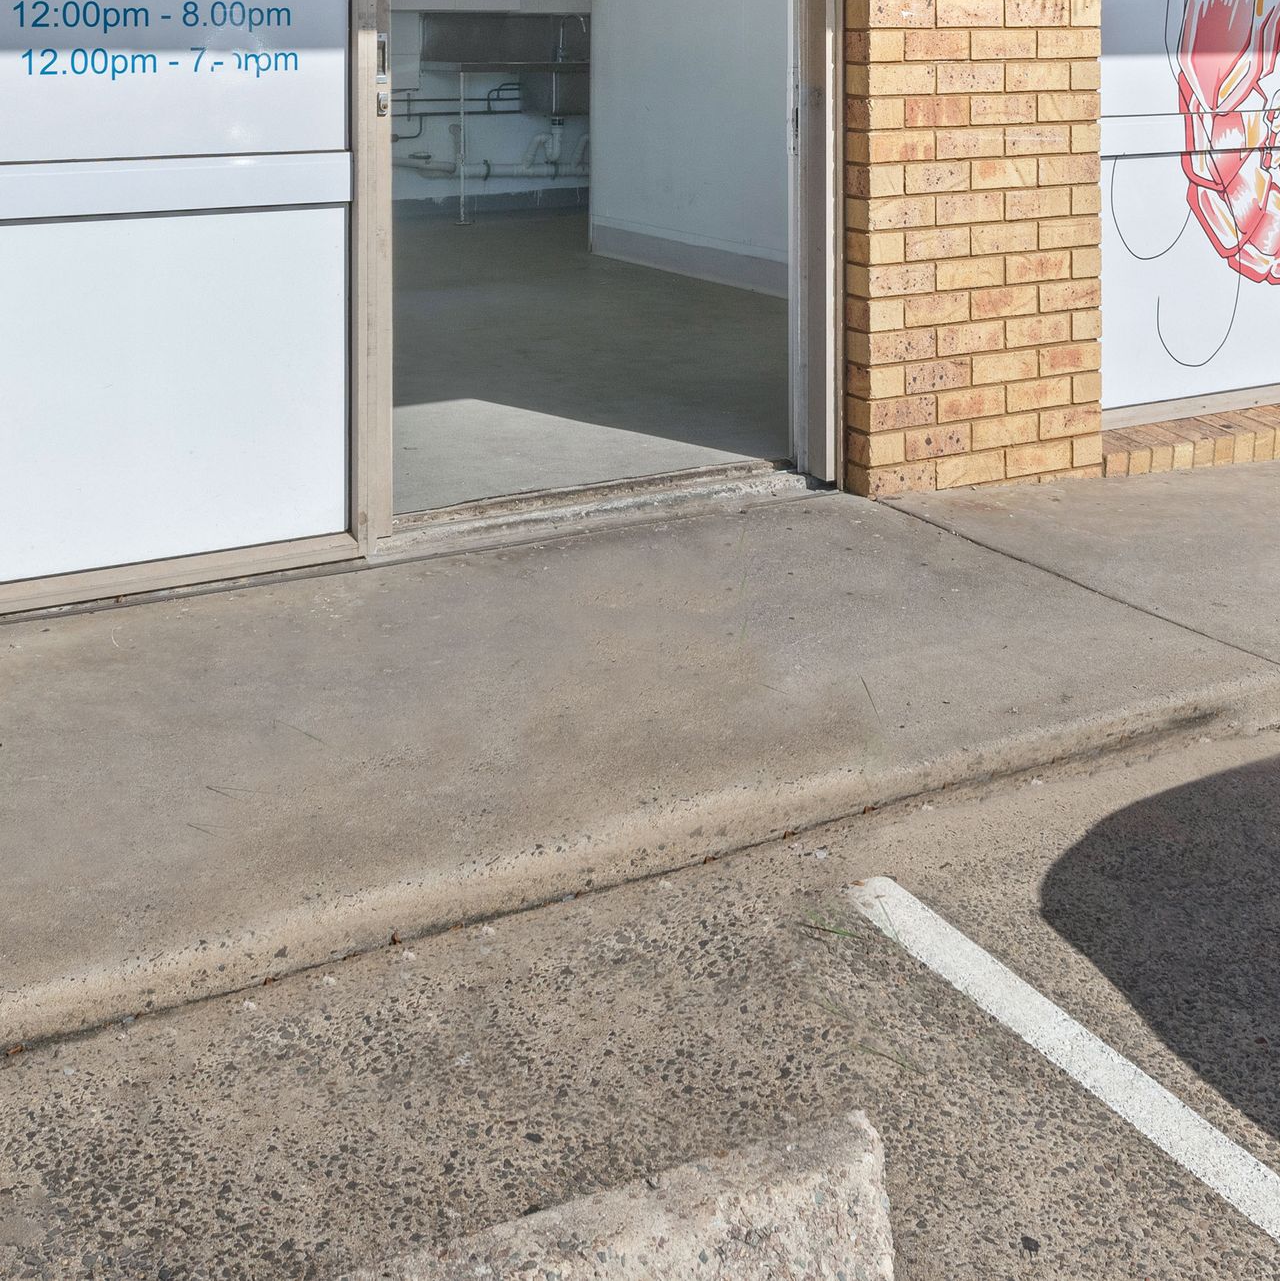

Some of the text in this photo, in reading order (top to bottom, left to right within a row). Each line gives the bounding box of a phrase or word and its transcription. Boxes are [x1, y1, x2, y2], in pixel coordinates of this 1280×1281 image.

[13, 0, 150, 33] 12:00pm
[181, 0, 293, 34] 8.00pm
[21, 47, 158, 82] 12.00pm
